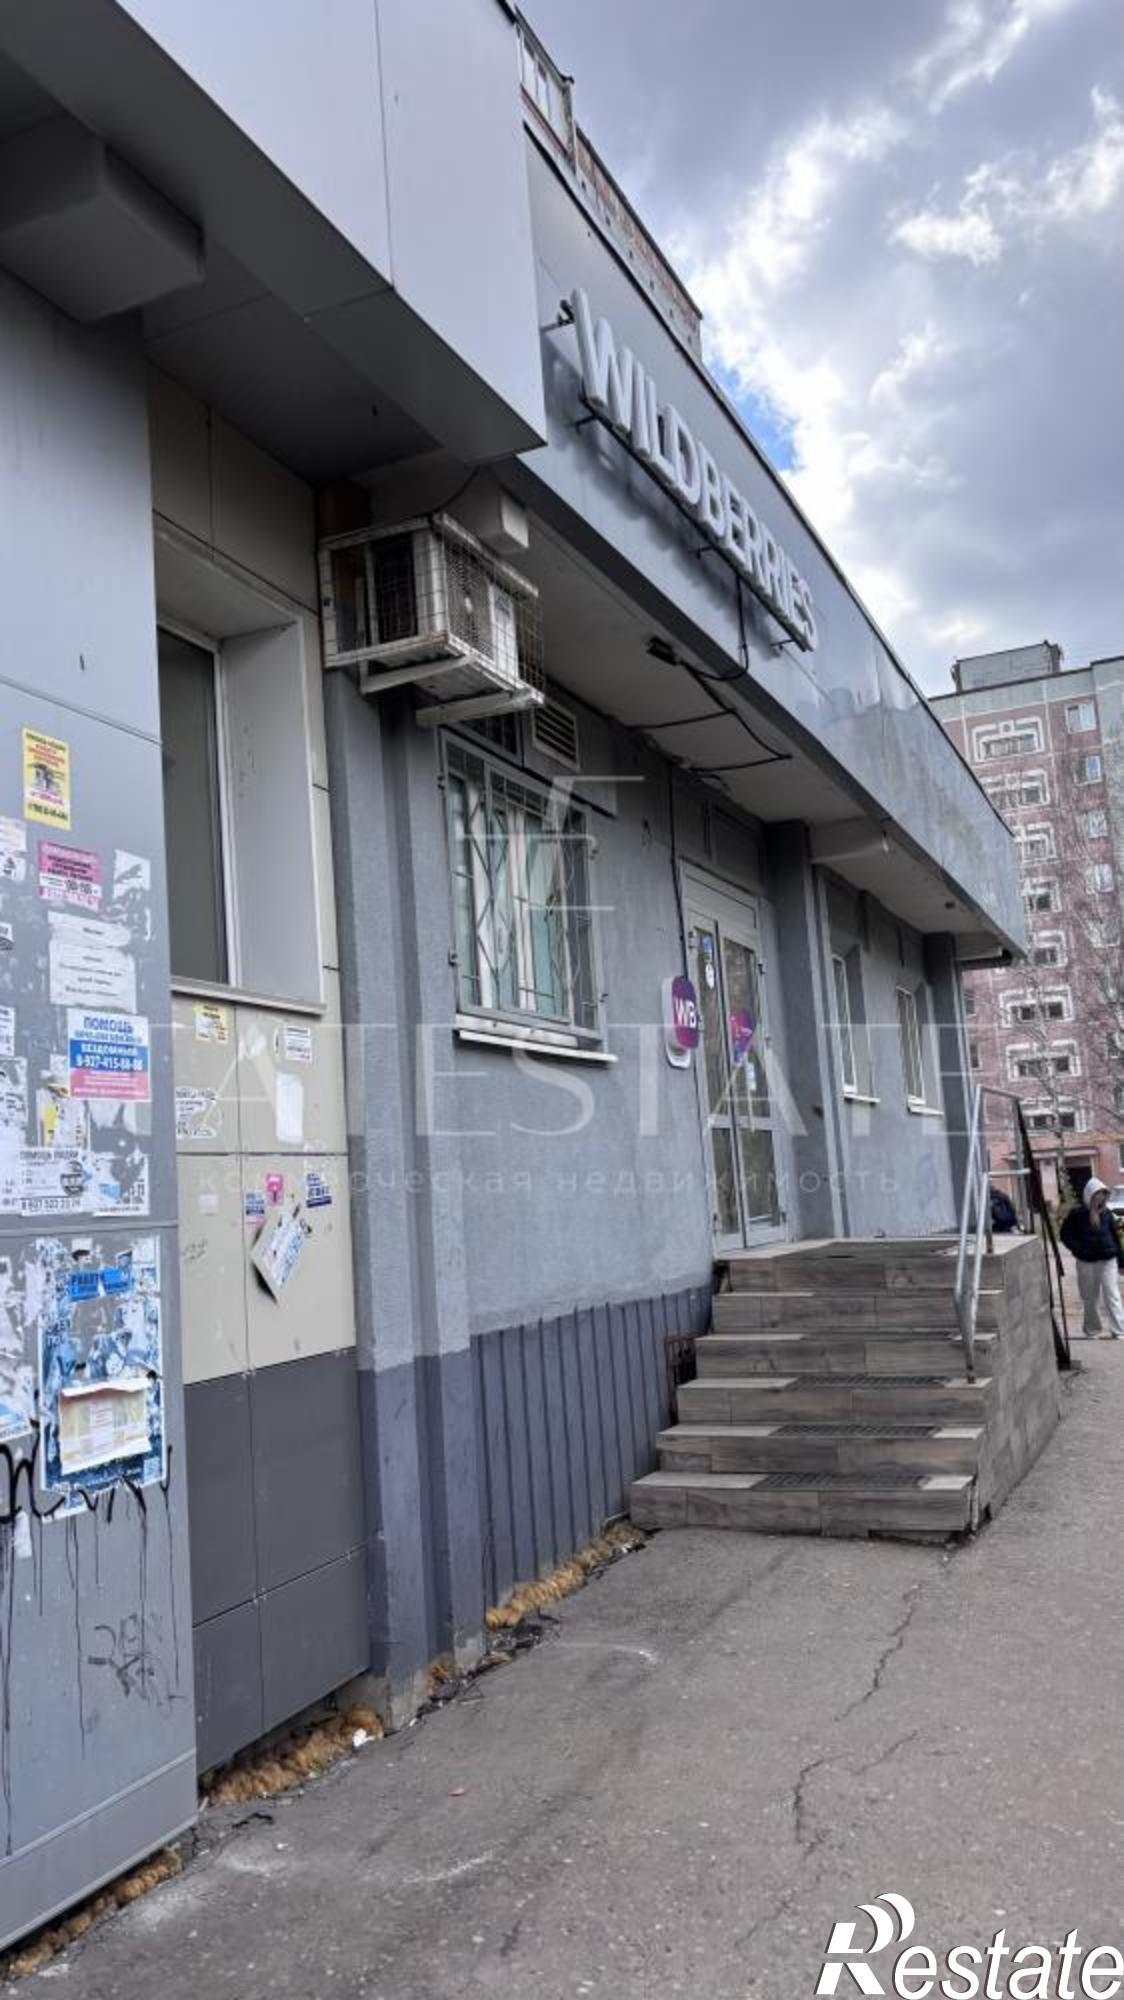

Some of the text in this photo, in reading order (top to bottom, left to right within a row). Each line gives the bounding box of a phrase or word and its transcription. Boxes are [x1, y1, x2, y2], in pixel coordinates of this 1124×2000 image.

[570, 287, 818, 653] WILDBERRIES
[83, 1016, 134, 1034] ПОМОЩЬ
[674, 996, 697, 1028] WB
